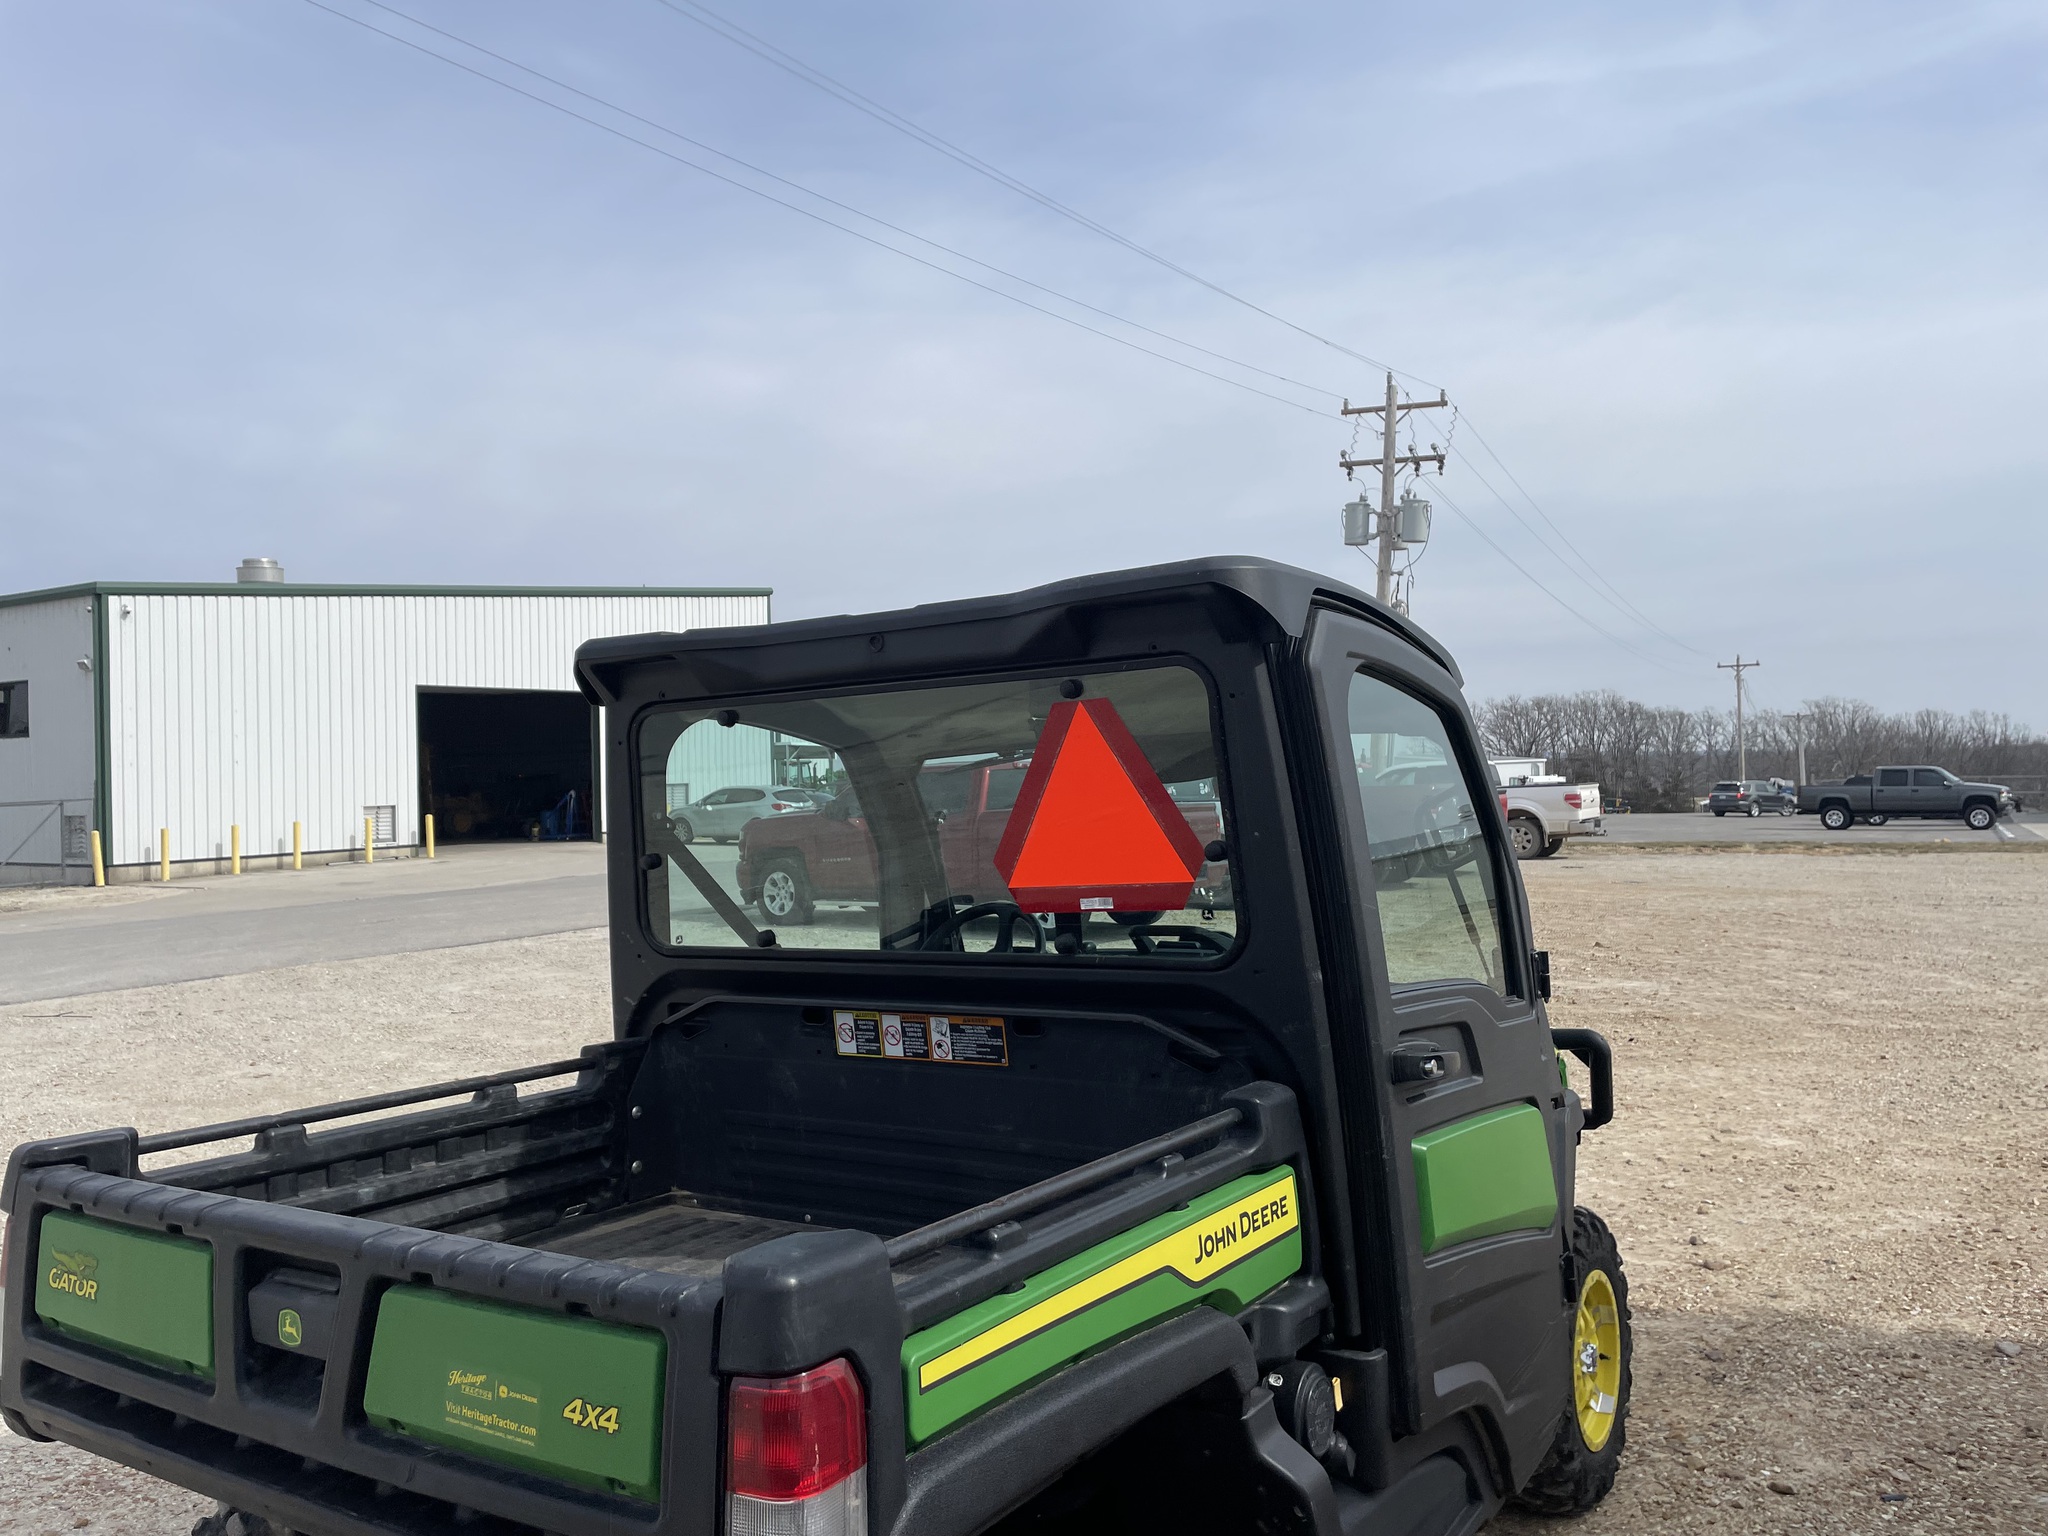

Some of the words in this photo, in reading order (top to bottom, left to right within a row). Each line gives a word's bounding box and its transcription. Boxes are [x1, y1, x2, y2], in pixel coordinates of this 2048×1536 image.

[1194, 1221, 1237, 1265] JOHN
[1238, 1194, 1289, 1240] DEERE
[48, 1267, 99, 1300] GATOR
[447, 1369, 488, 1386] Heritage
[445, 1399, 461, 1415] Visit
[461, 1404, 537, 1437] HeritageTractor.com
